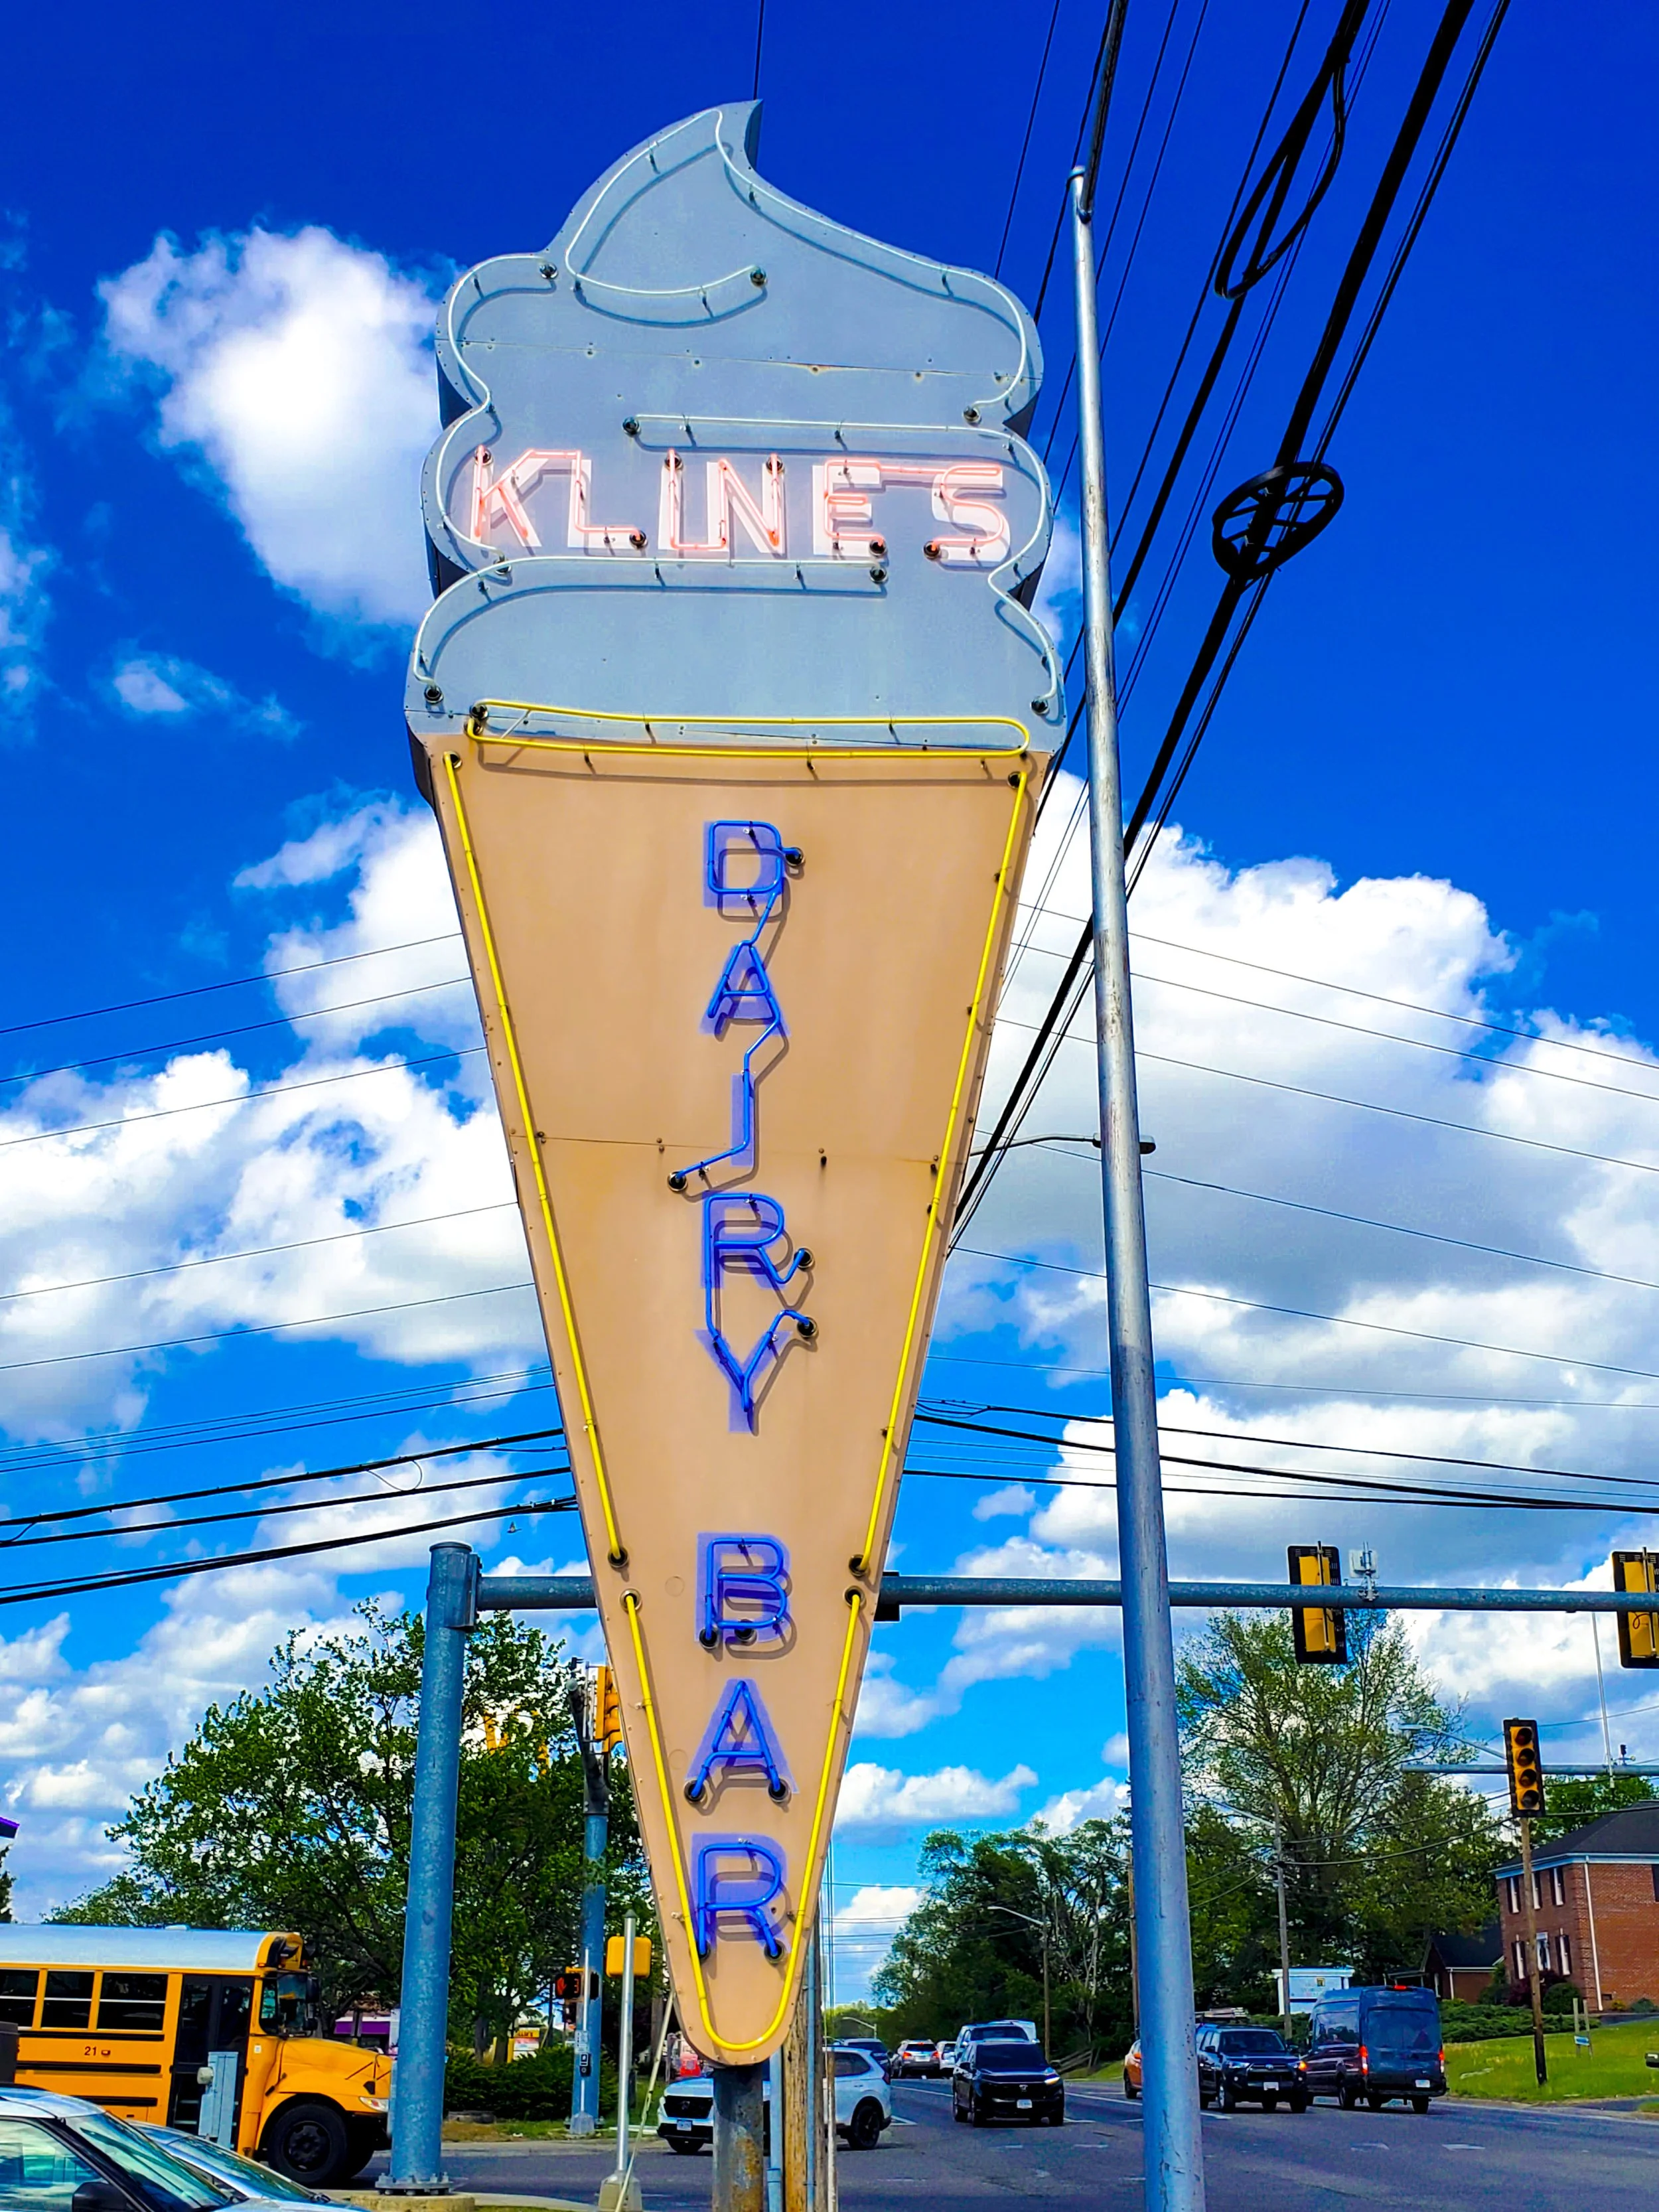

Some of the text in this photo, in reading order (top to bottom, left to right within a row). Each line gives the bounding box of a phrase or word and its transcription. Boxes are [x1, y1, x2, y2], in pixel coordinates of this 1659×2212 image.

[693, 820, 796, 1434] DAIRY
[685, 1532, 800, 1958] BAR
[84, 2045, 98, 2056] 21
